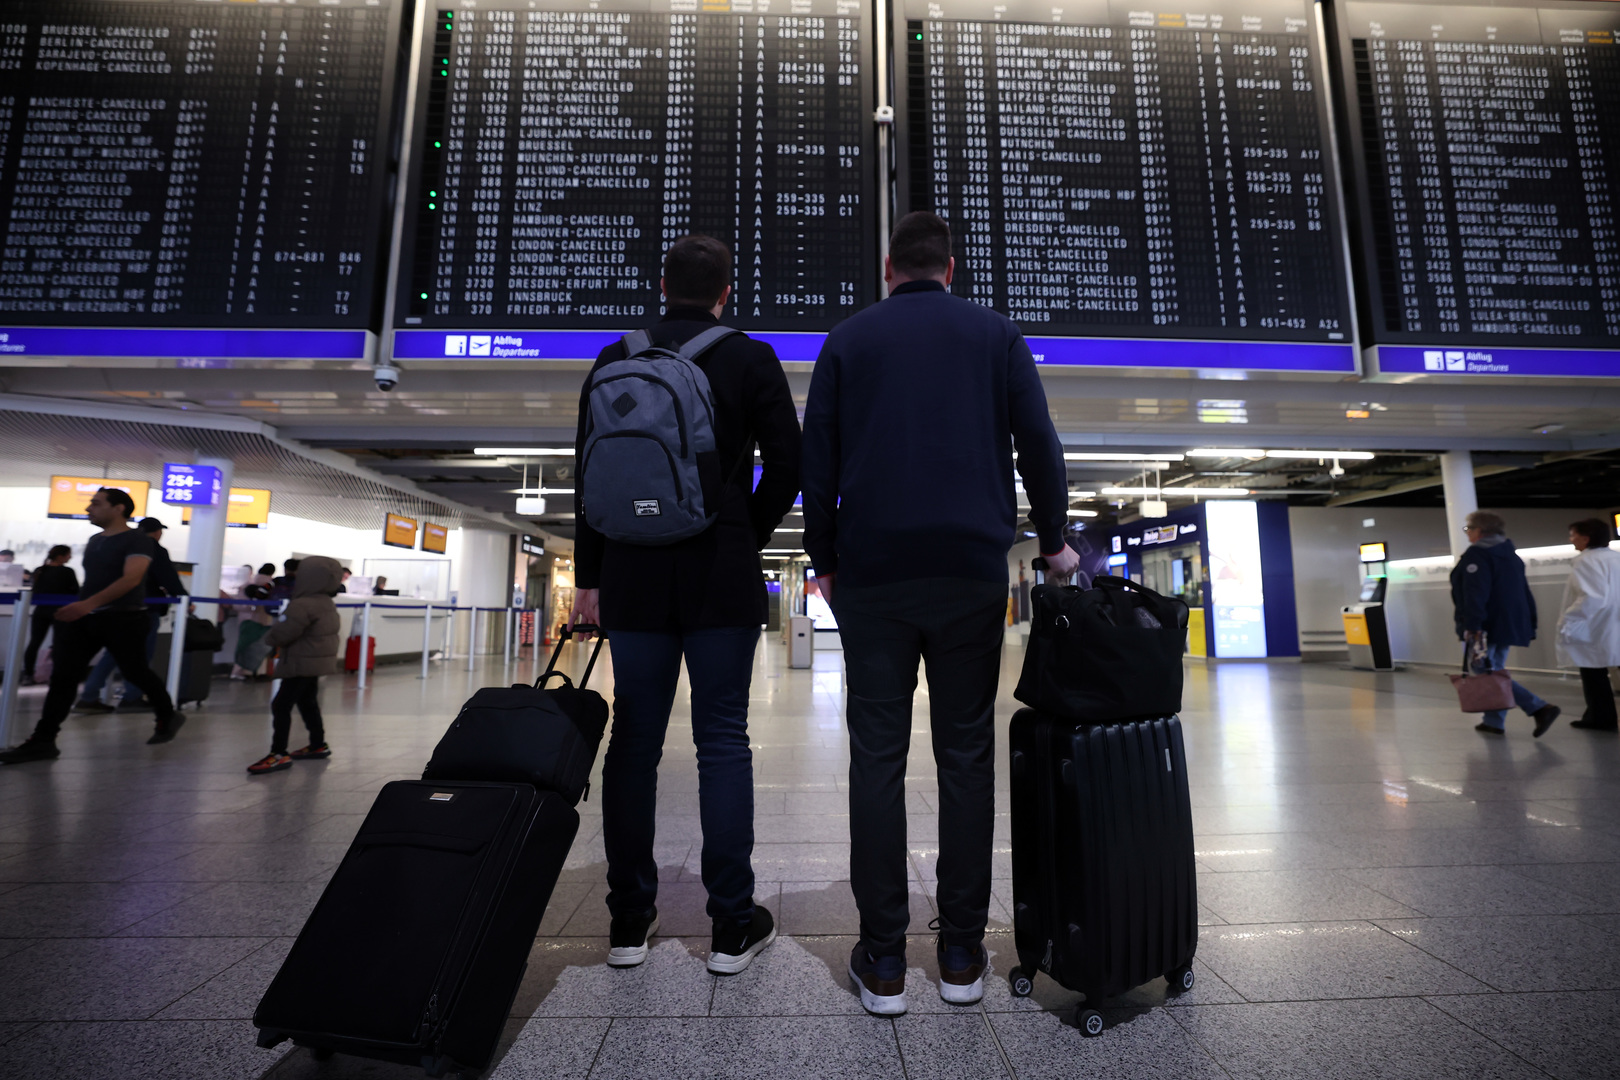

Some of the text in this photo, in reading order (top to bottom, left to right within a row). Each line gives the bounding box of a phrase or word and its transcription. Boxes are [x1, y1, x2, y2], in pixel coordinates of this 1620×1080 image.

[42, 25, 169, 38] BRUESSEL-CANCELLED
[995, 24, 1111, 38] LISSABON-CANCELLED
[40, 38, 154, 50] BERLIN-CANCELLED
[996, 35, 1021, 46] GENF
[38, 49, 165, 62] SARAJEVO-CANCELLED
[996, 46, 1087, 59] DORTMUND-KOELN
[36, 61, 171, 74] KOPENHAGE-CANCELLED
[525, 57, 641, 69] PALMA DE MALLORCA
[997, 57, 1035, 68] BREMEN
[524, 69, 620, 80] MAILAND-LINATE
[998, 69, 1088, 81] MAILAND-LINATE
[523, 81, 633, 92] BERLIN-CANCELLED
[998, 80, 1116, 94] MUENSTER-CANCELLED
[522, 92, 619, 104] LYON-CANCELLED
[999, 91, 1110, 105] LEIPZIG-CANCELLED
[521, 104, 618, 116] PRAG-CANCELLED
[999, 103, 1111, 116] MAILAND-CANCELLED
[521, 116, 631, 128] BREMEN-CANCELLED
[1000, 115, 1125, 128] NEWCASTLE-CANCELLED
[1524, 111, 1560, 122] GAULLE
[520, 128, 652, 140] LJUBLJANA-CANCELLED
[519, 140, 574, 151] BRUESSEL
[777, 144, 825, 155] 259-335
[839, 145, 859, 155] B10
[476, 152, 658, 164] 3404 MUENCHEN-STUTTGART-U
[1002, 150, 1101, 163] PARIS-CANCELLED
[517, 165, 636, 176] BILLUND-CANCELLED
[968, 161, 1322, 183] 202 WIEN 259-335 A16
[1452, 166, 1551, 179] BERLIN-CANCELLED
[17, 172, 126, 183] NIZZA-CANCELLED
[516, 177, 649, 189] AMSTERDAM-CANCELLED
[15, 184, 132, 196] KRAKAU-CANCELLED
[969, 173, 988, 183] 763
[1003, 174, 1062, 185] GAZIANTEP
[1305, 185, 1323, 195] B41
[515, 189, 564, 200] ZUERICH
[777, 193, 825, 203] 259-335
[840, 194, 858, 204] A11
[963, 185, 1318, 206] 3504 DUS HBF-SIEGBURG HBF T7
[1455, 191, 1499, 201] ATLANTA
[13, 197, 122, 208] PARIS-CANCELLED
[1004, 198, 1064, 210] STUTTGART
[1072, 200, 1091, 210] HBF
[11, 209, 150, 221] MARSEILLE-CANCELLED
[514, 202, 541, 212] LINZ
[777, 205, 825, 216] 259-335
[840, 206, 851, 216] C1
[514, 214, 633, 226] HAMBURG-CANCELLED
[1005, 211, 1064, 222] LUXEMBURG
[513, 227, 640, 238] HANNOVER-CANCELLED
[971, 222, 1120, 236] 206 DRESDEN-CANCELLED
[476, 239, 625, 251] 902 LONDON-CANCELLED
[966, 234, 1127, 248] 1160 VALENCIA-CANCELLED
[511, 253, 624, 264] LONDON-CANCELLED
[966, 247, 1108, 260] 1202 BASEL-CANCELLED
[468, 265, 638, 277] 1102 SALZBURG-CANCELLED
[967, 259, 1109, 273] 1278 ATHEN-CANCELLED
[466, 278, 853, 292] 3730 DRESDEN-ERFURT HHB-L T4
[974, 272, 1137, 286] 128 STUTTGART-CANCELLED
[973, 285, 1138, 298] 810 GOETEBORG-CANCELLED
[1467, 286, 1494, 296] RIGA
[465, 291, 853, 305] 8050 INNSBRUCK 259-335 B3
[471, 304, 644, 316] 370 FRIEDR.HF-CANCELLED
[1009, 298, 1139, 311] CASABLANC-CANCELLED
[1261, 317, 1306, 329] 451-452
[1319, 319, 1338, 329] A24
[493, 336, 522, 347] Abflug
[492, 347, 540, 358] Departures
[165, 488, 194, 501] 285
